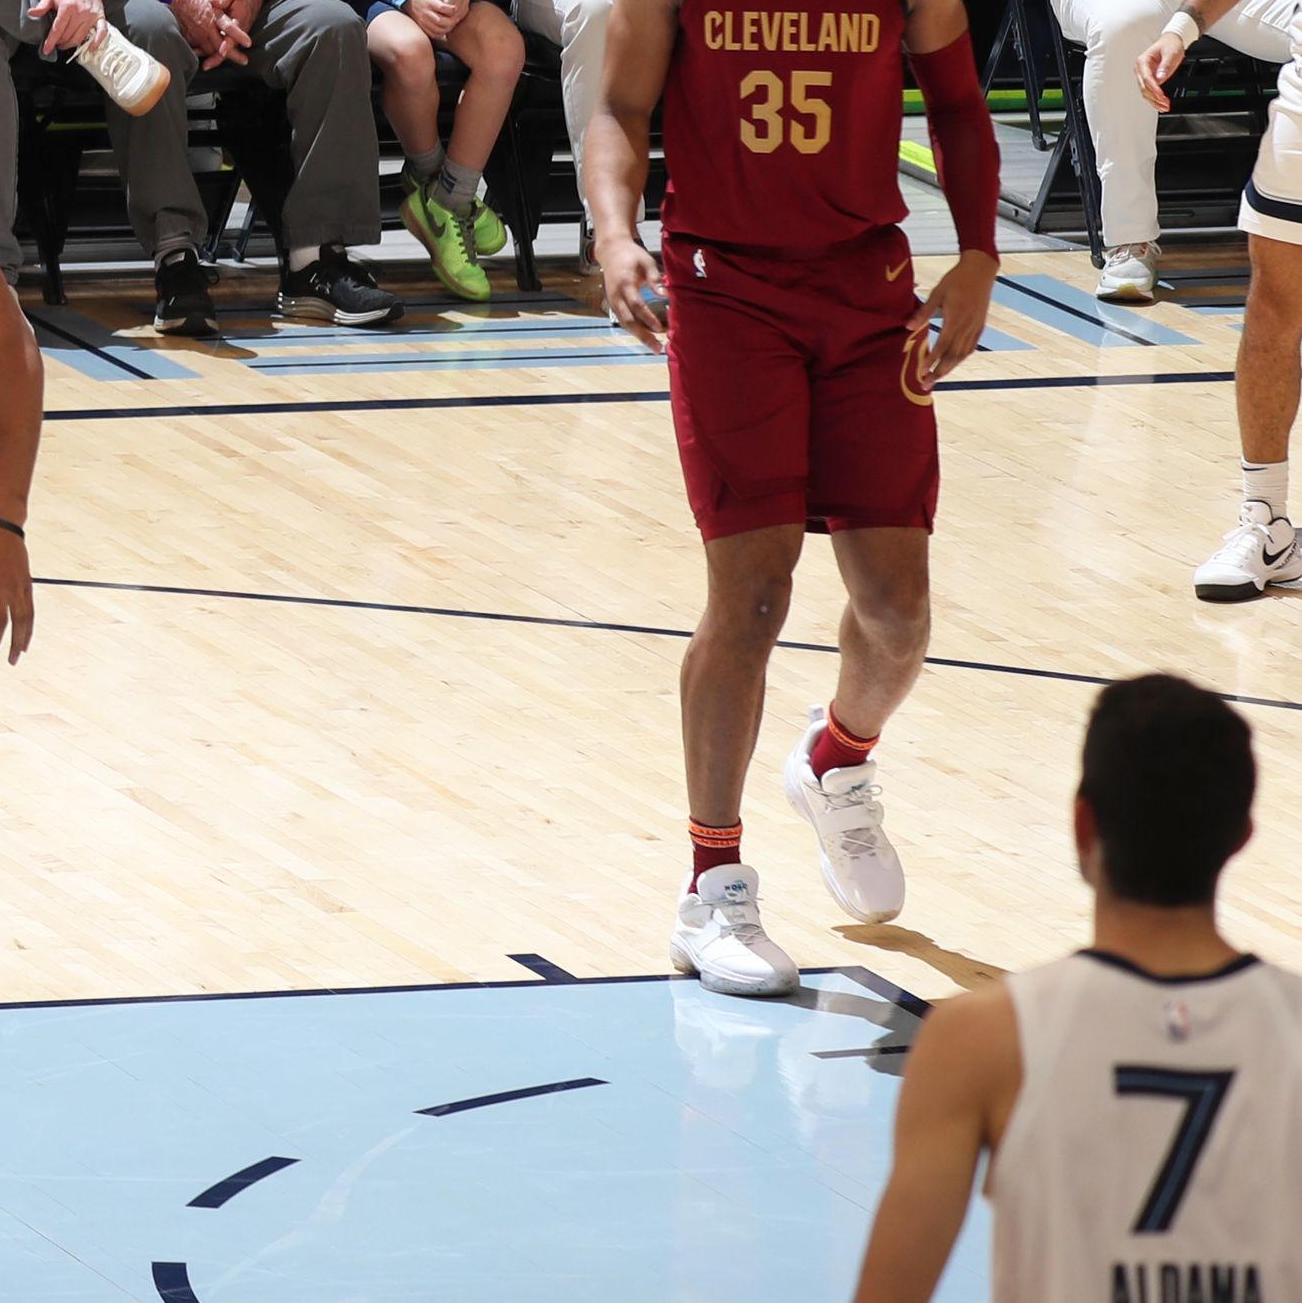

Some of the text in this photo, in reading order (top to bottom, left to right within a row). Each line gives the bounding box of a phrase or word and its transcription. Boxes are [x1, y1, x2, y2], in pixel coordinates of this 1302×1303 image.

[704, 10, 881, 53] CLEVELAND
[740, 70, 833, 155] 35
[1112, 1064, 1237, 1235] 7
